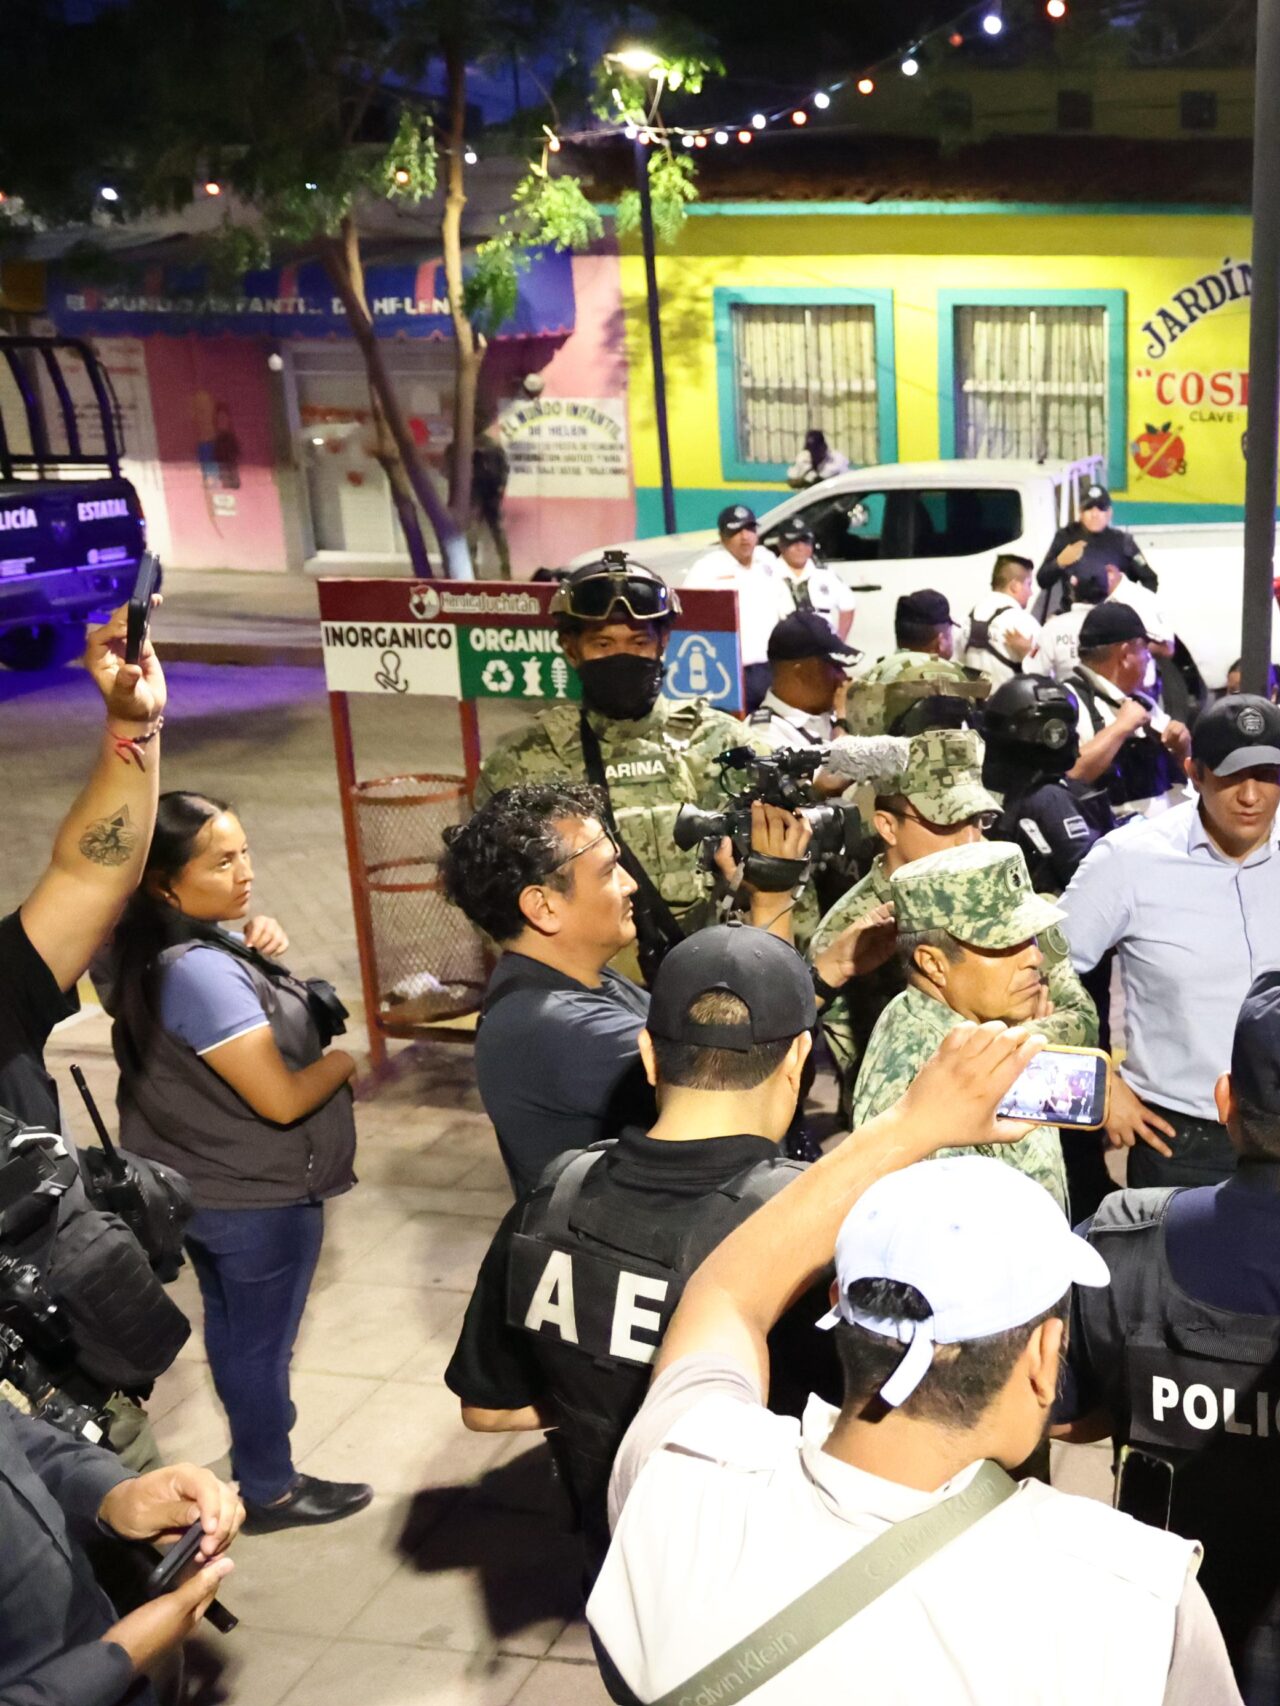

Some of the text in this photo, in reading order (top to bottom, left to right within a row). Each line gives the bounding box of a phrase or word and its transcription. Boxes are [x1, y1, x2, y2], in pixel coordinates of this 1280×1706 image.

[77, 498, 129, 521] ESTATAL
[325, 625, 451, 649] INORGANICO
[604, 759, 666, 779] ARINA
[737, 1630, 799, 1680] Klein
